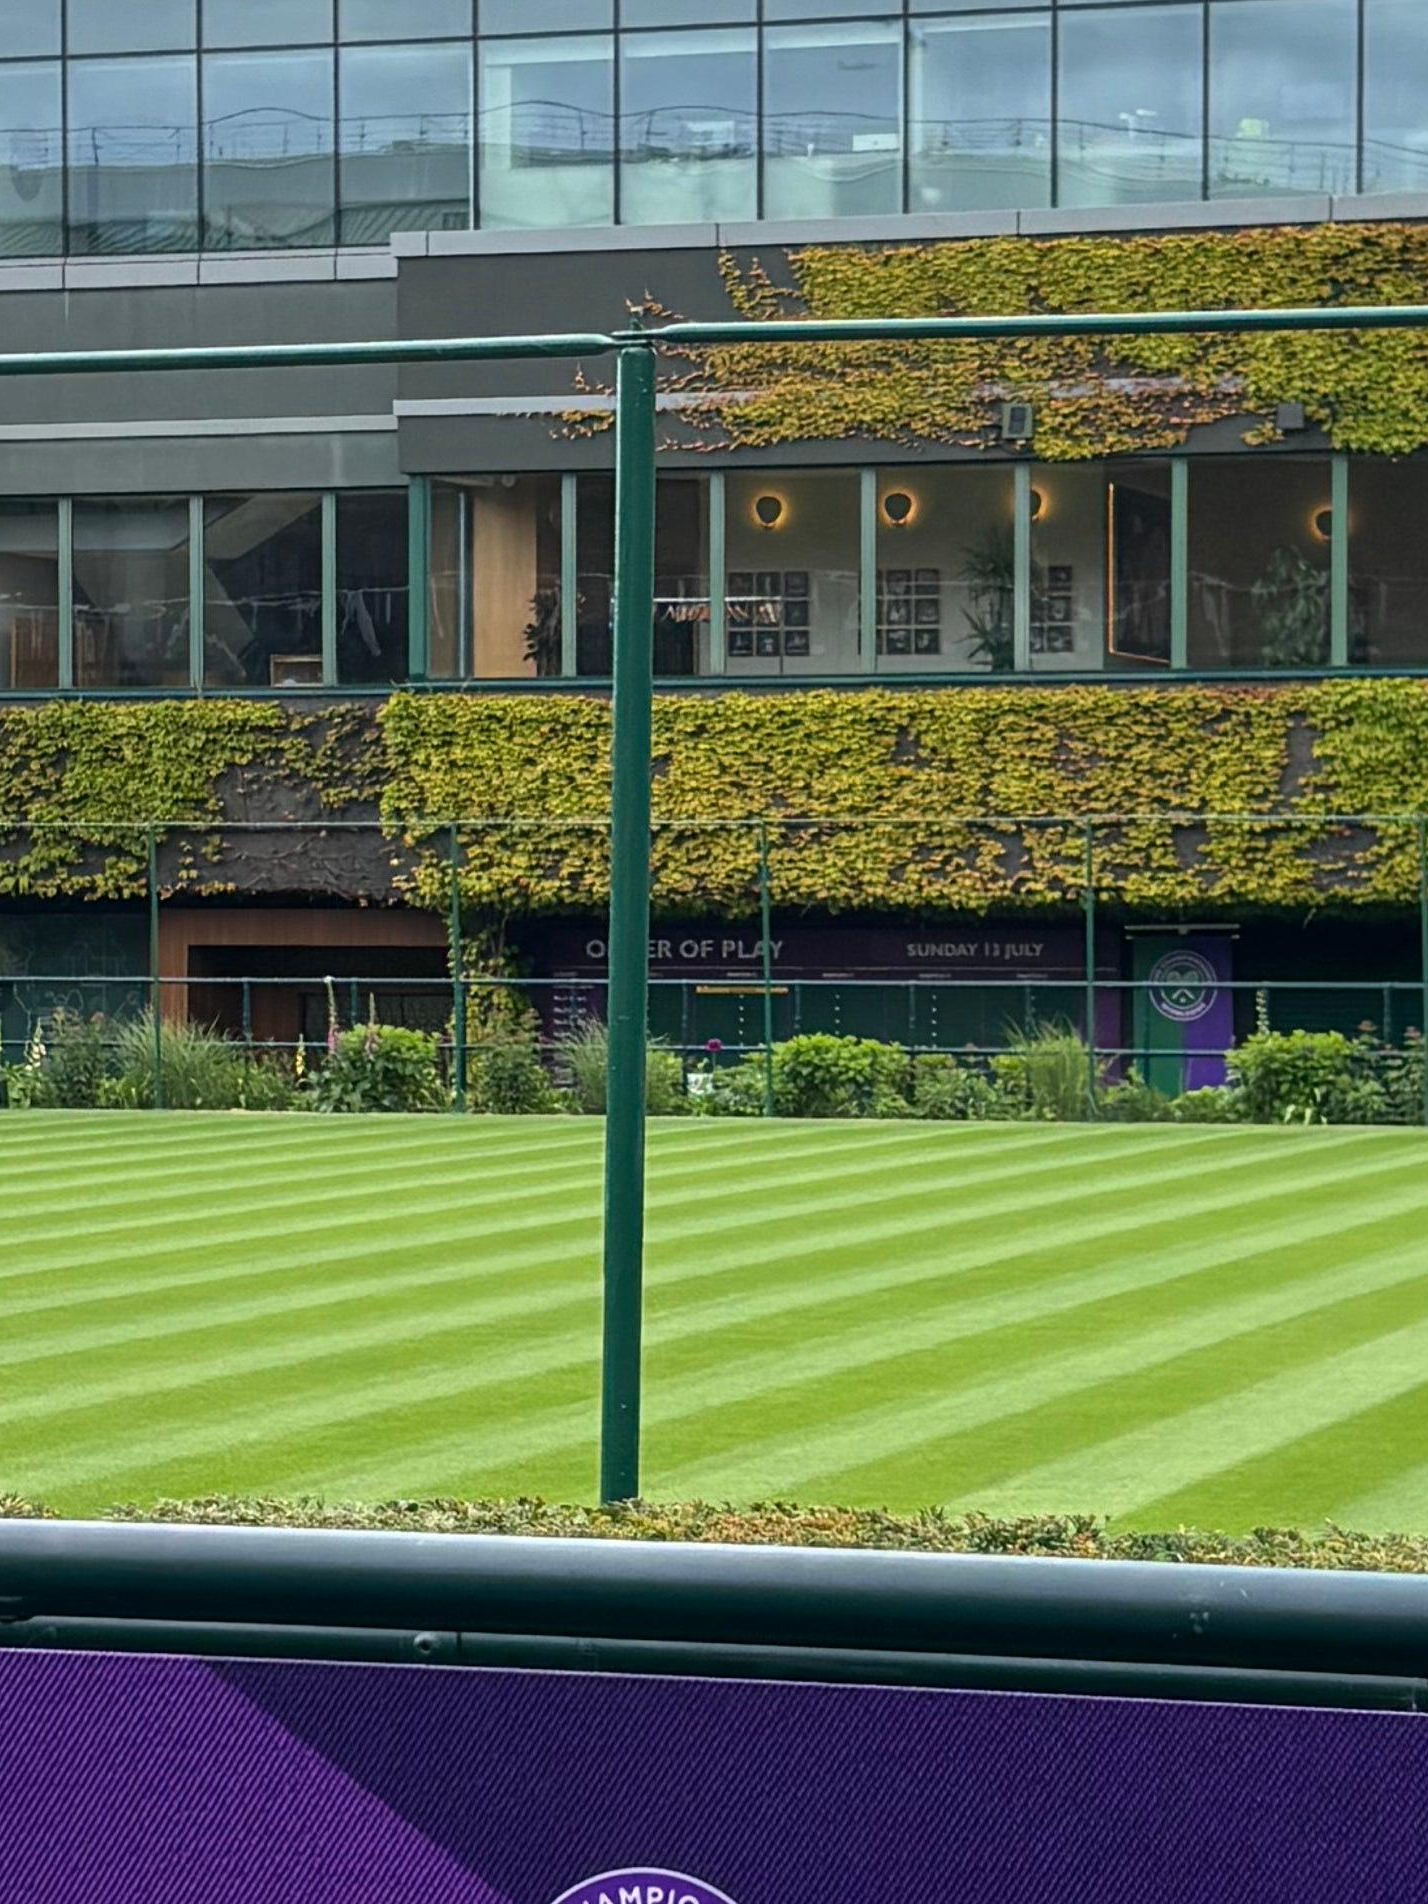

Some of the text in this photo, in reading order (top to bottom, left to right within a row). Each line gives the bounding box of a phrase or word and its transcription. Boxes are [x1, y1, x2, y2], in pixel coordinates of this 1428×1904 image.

[585, 939, 783, 959] OER OF PLAY
[906, 942, 978, 957] SUNDAY
[1003, 942, 1044, 960] JULY
